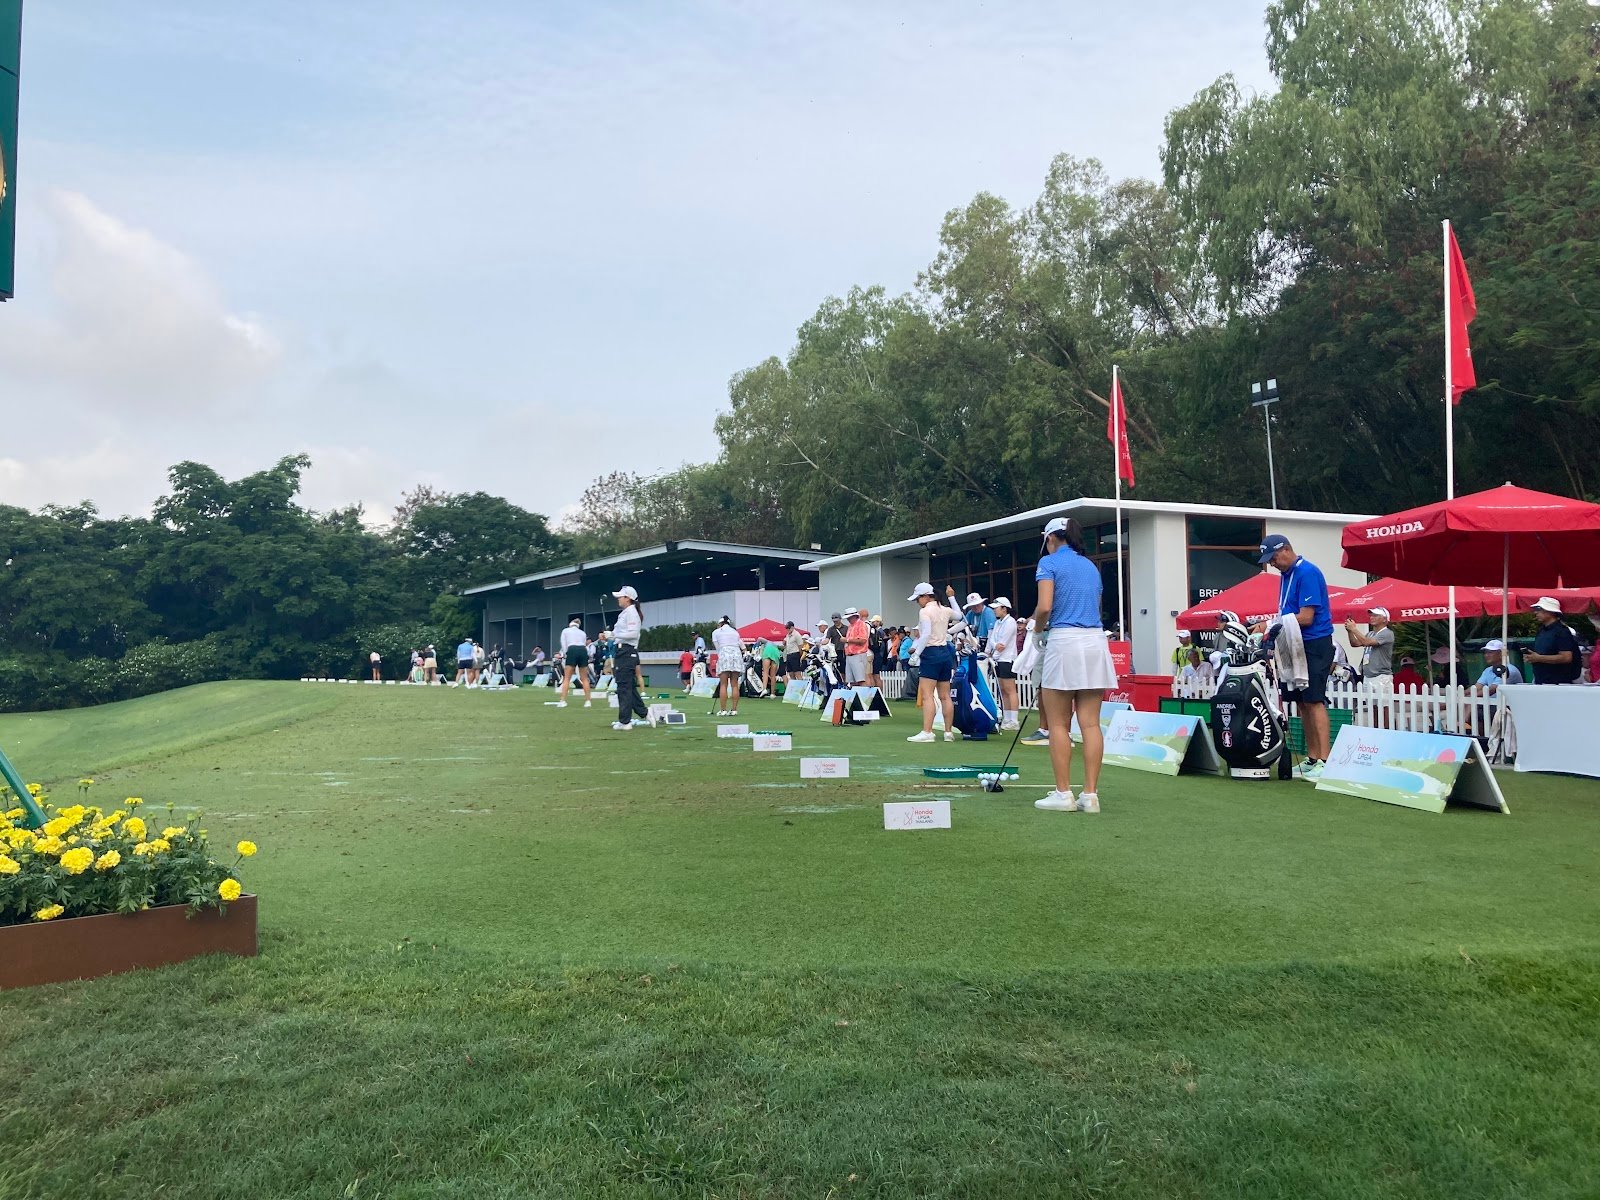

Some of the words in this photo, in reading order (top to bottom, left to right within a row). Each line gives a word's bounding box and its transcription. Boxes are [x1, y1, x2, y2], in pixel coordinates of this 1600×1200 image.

[1366, 521, 1425, 538] HONDA
[1401, 606, 1459, 617] HONDA
[1250, 696, 1272, 750] Callaway
[1358, 744, 1379, 754] Honda
[1358, 753, 1372, 761] LPGA
